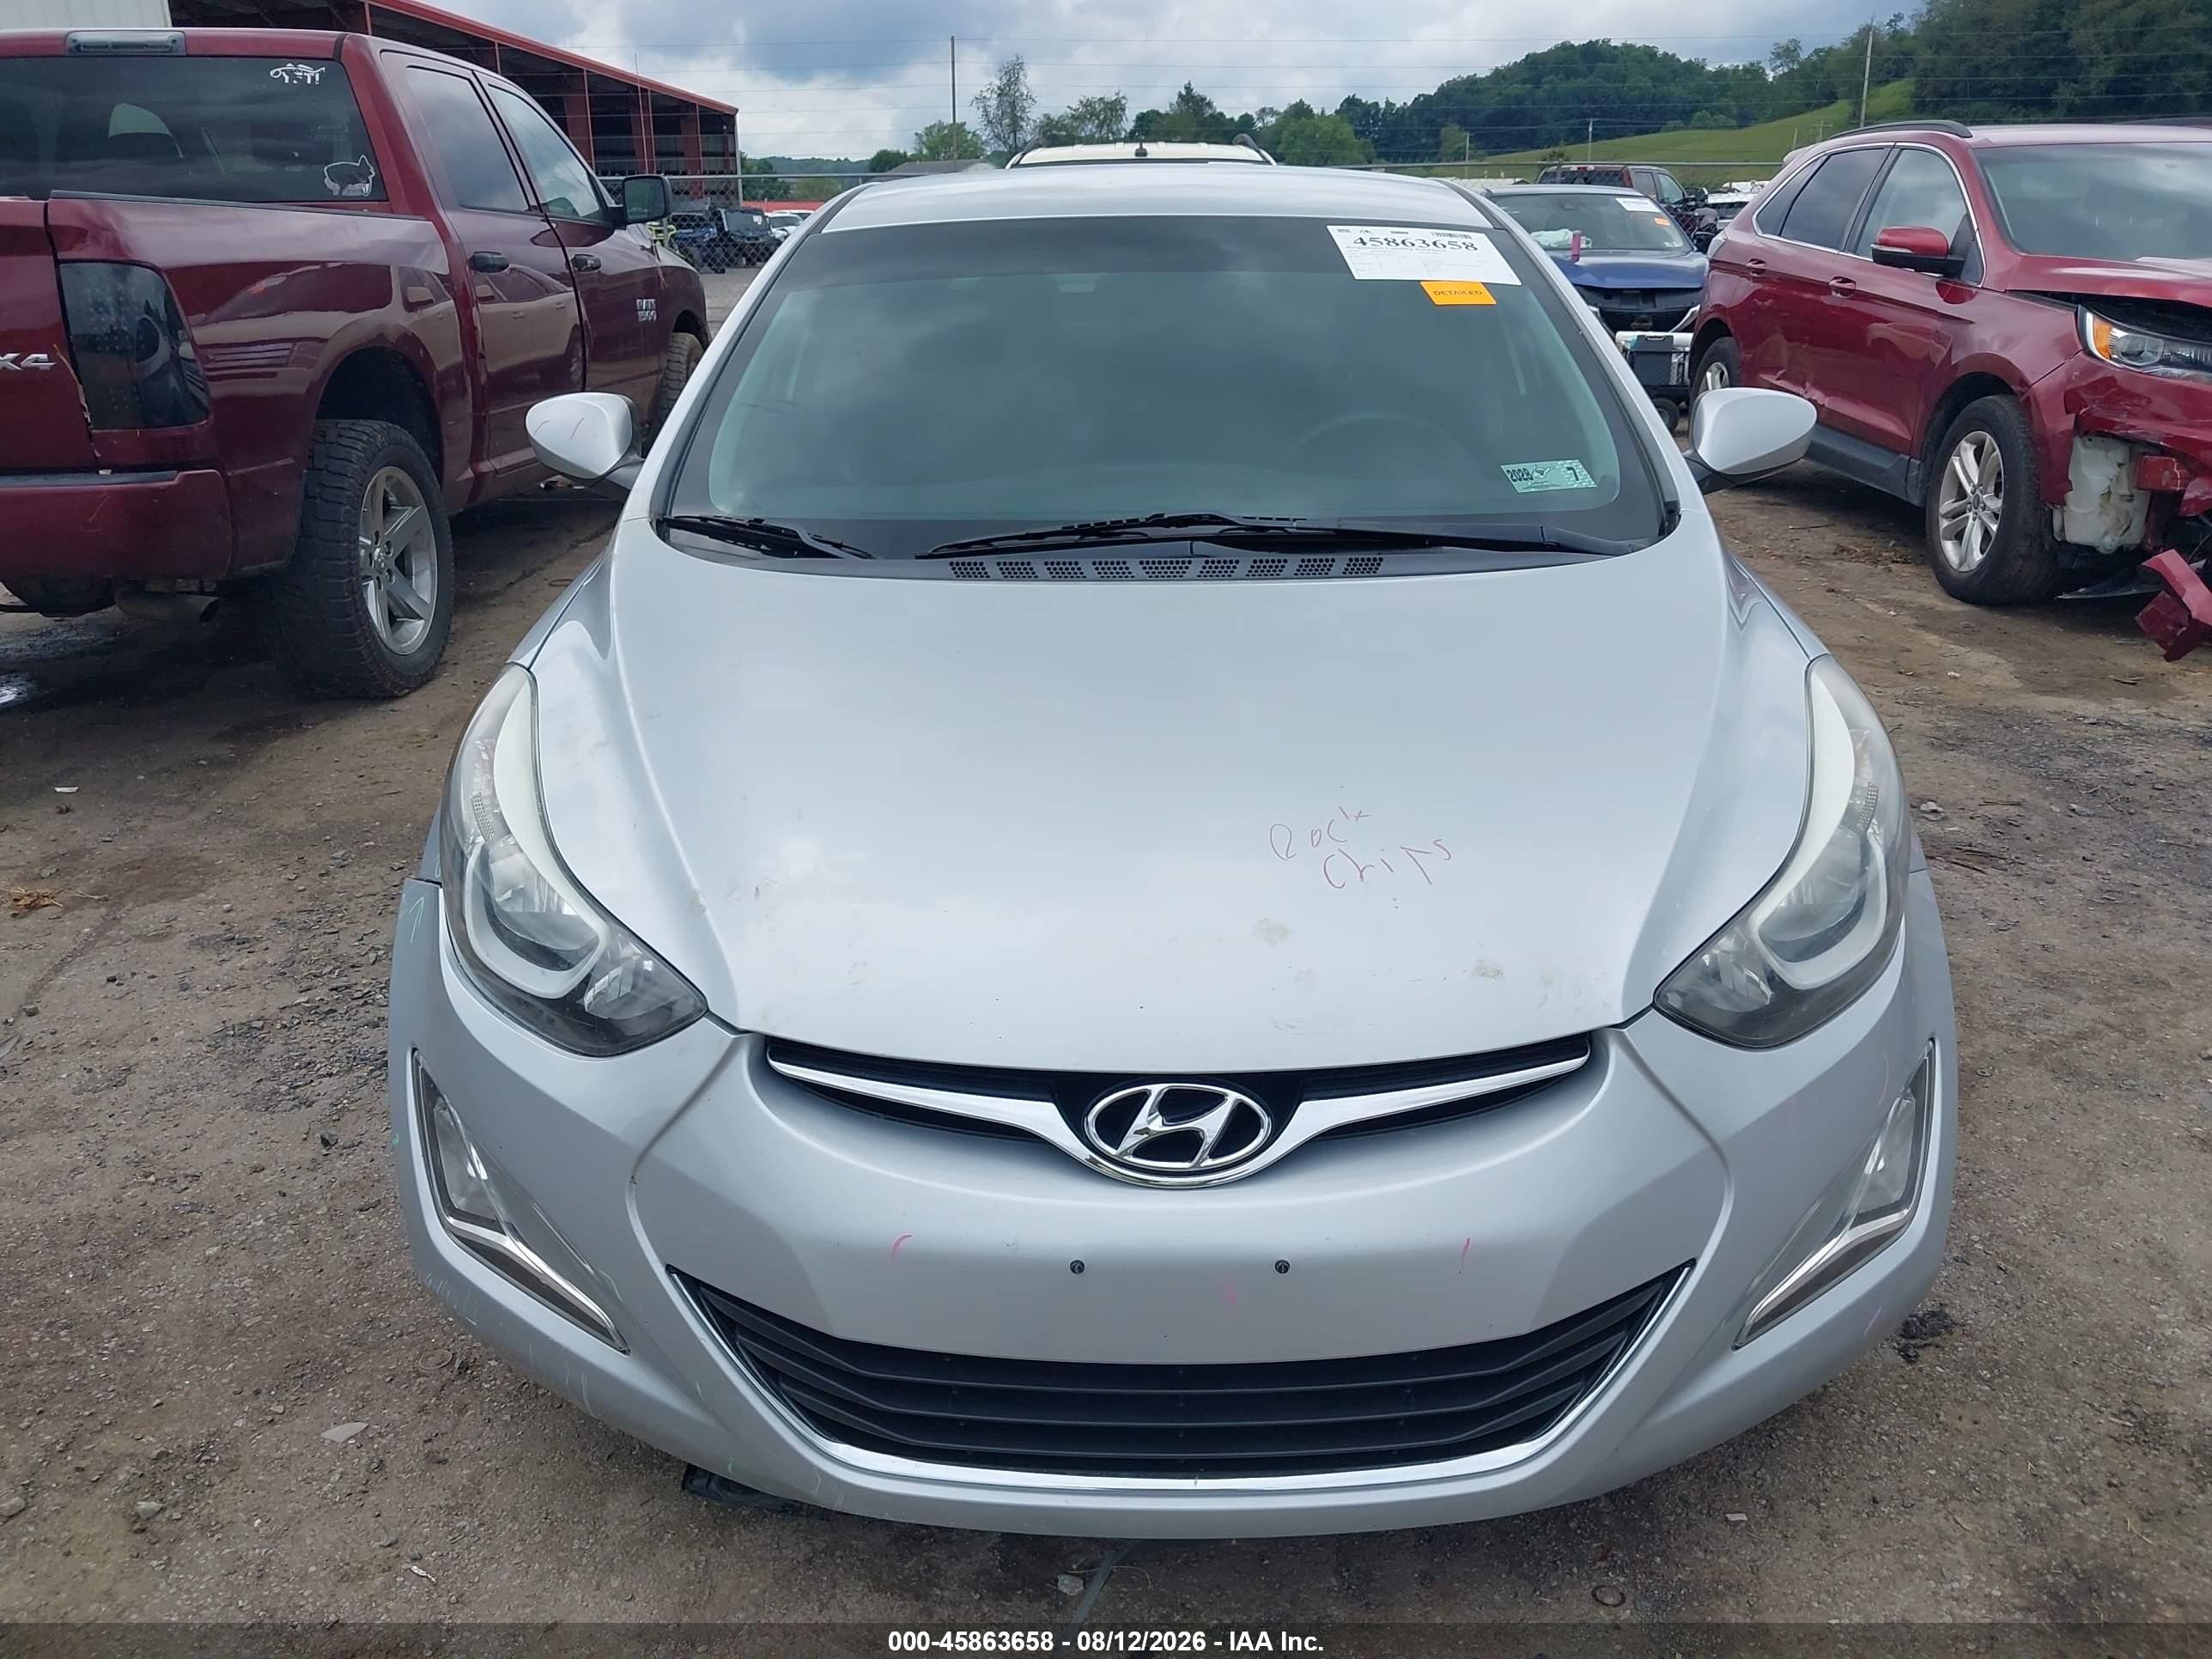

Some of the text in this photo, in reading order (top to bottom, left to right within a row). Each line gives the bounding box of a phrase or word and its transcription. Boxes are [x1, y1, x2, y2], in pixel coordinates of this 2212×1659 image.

[1352, 236, 1479, 252] 45863658
[1505, 466, 1580, 483] 2028 7
